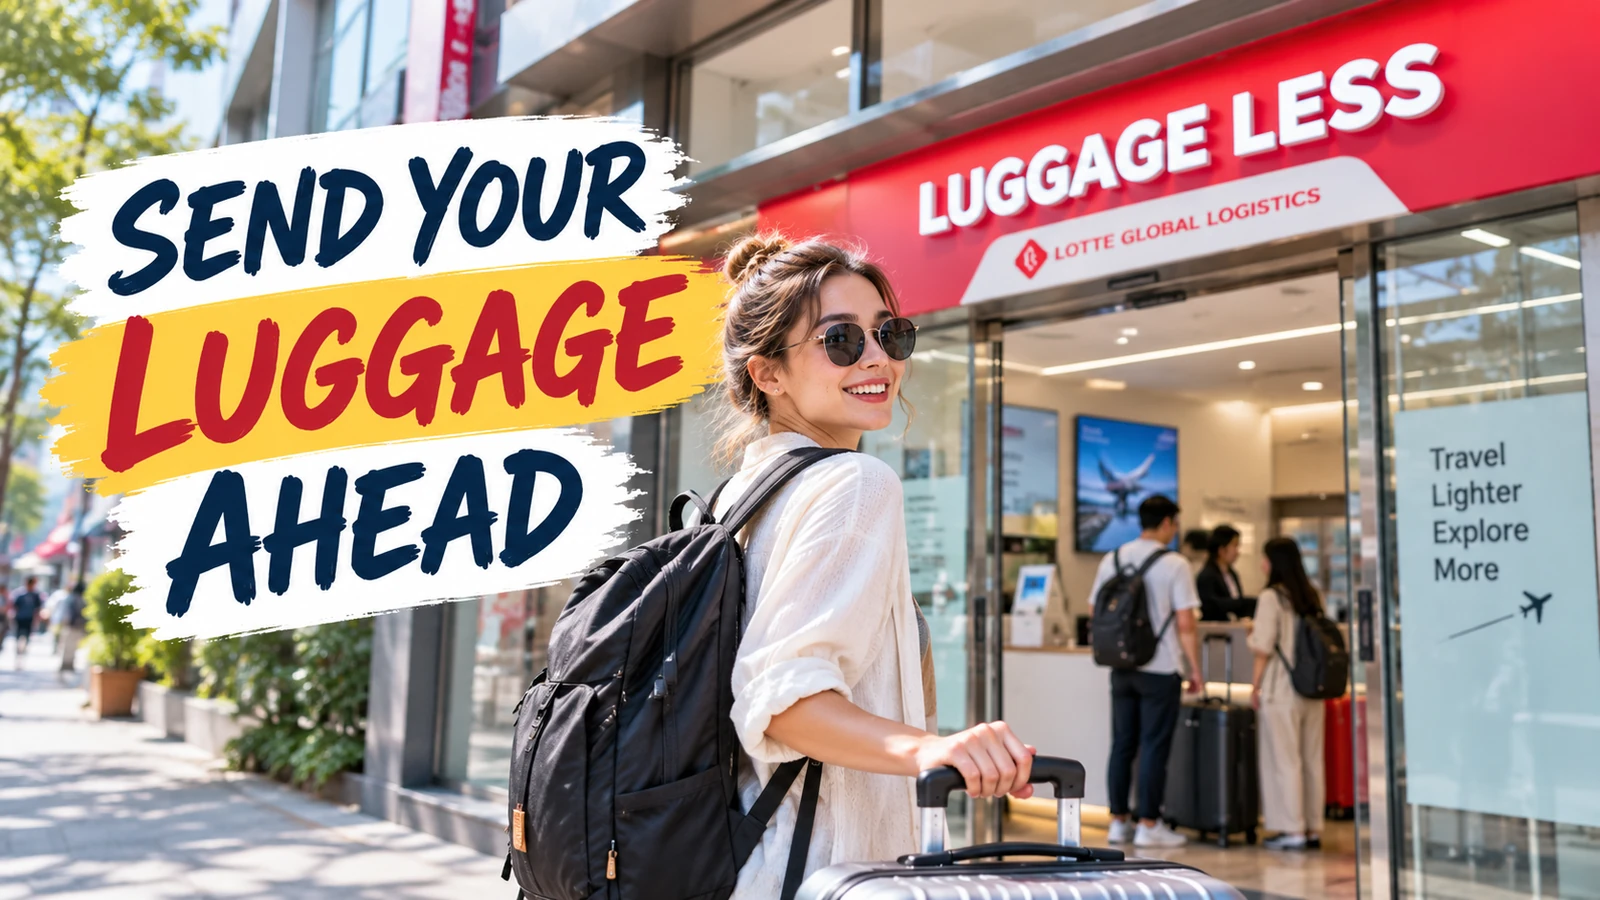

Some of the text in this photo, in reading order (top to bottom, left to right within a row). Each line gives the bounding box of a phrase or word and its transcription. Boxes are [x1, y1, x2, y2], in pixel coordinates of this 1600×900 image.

[919, 43, 1444, 235] LUGGAGE LESS
[1054, 187, 1322, 261] LOTTE GLOBAL LOGISTICS
[1430, 441, 1506, 471] Travel
[1432, 480, 1522, 512] Lighter
[1433, 518, 1529, 550] Explore
[1434, 557, 1499, 582] More
